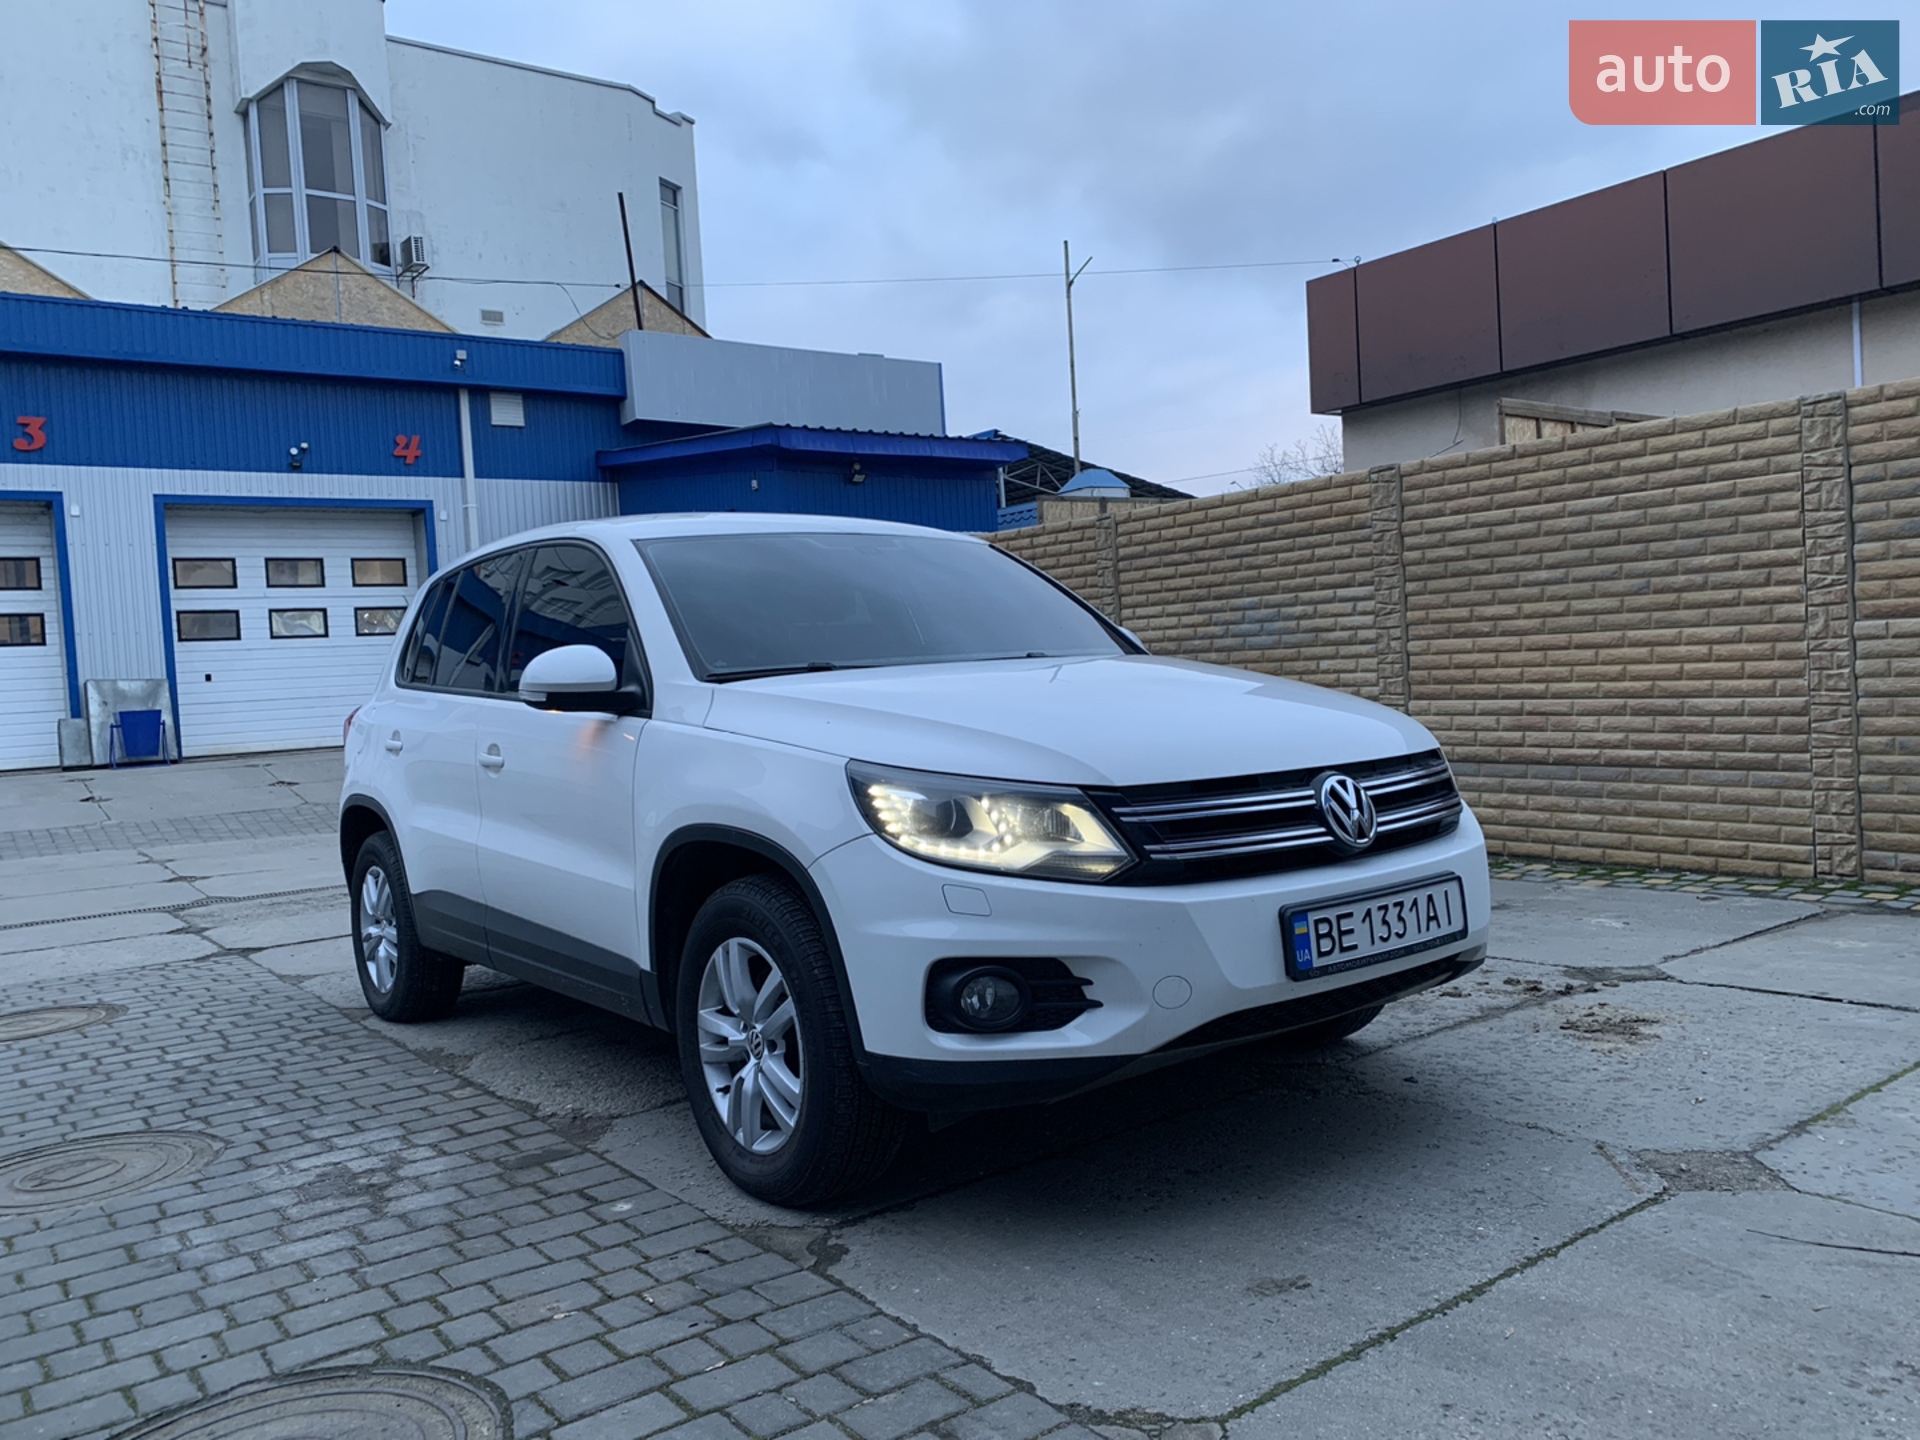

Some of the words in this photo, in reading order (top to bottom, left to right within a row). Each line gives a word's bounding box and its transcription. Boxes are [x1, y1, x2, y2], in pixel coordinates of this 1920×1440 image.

[13, 416, 46, 451] 3
[394, 434, 421, 464] 4
[1296, 948, 1312, 962] UA
